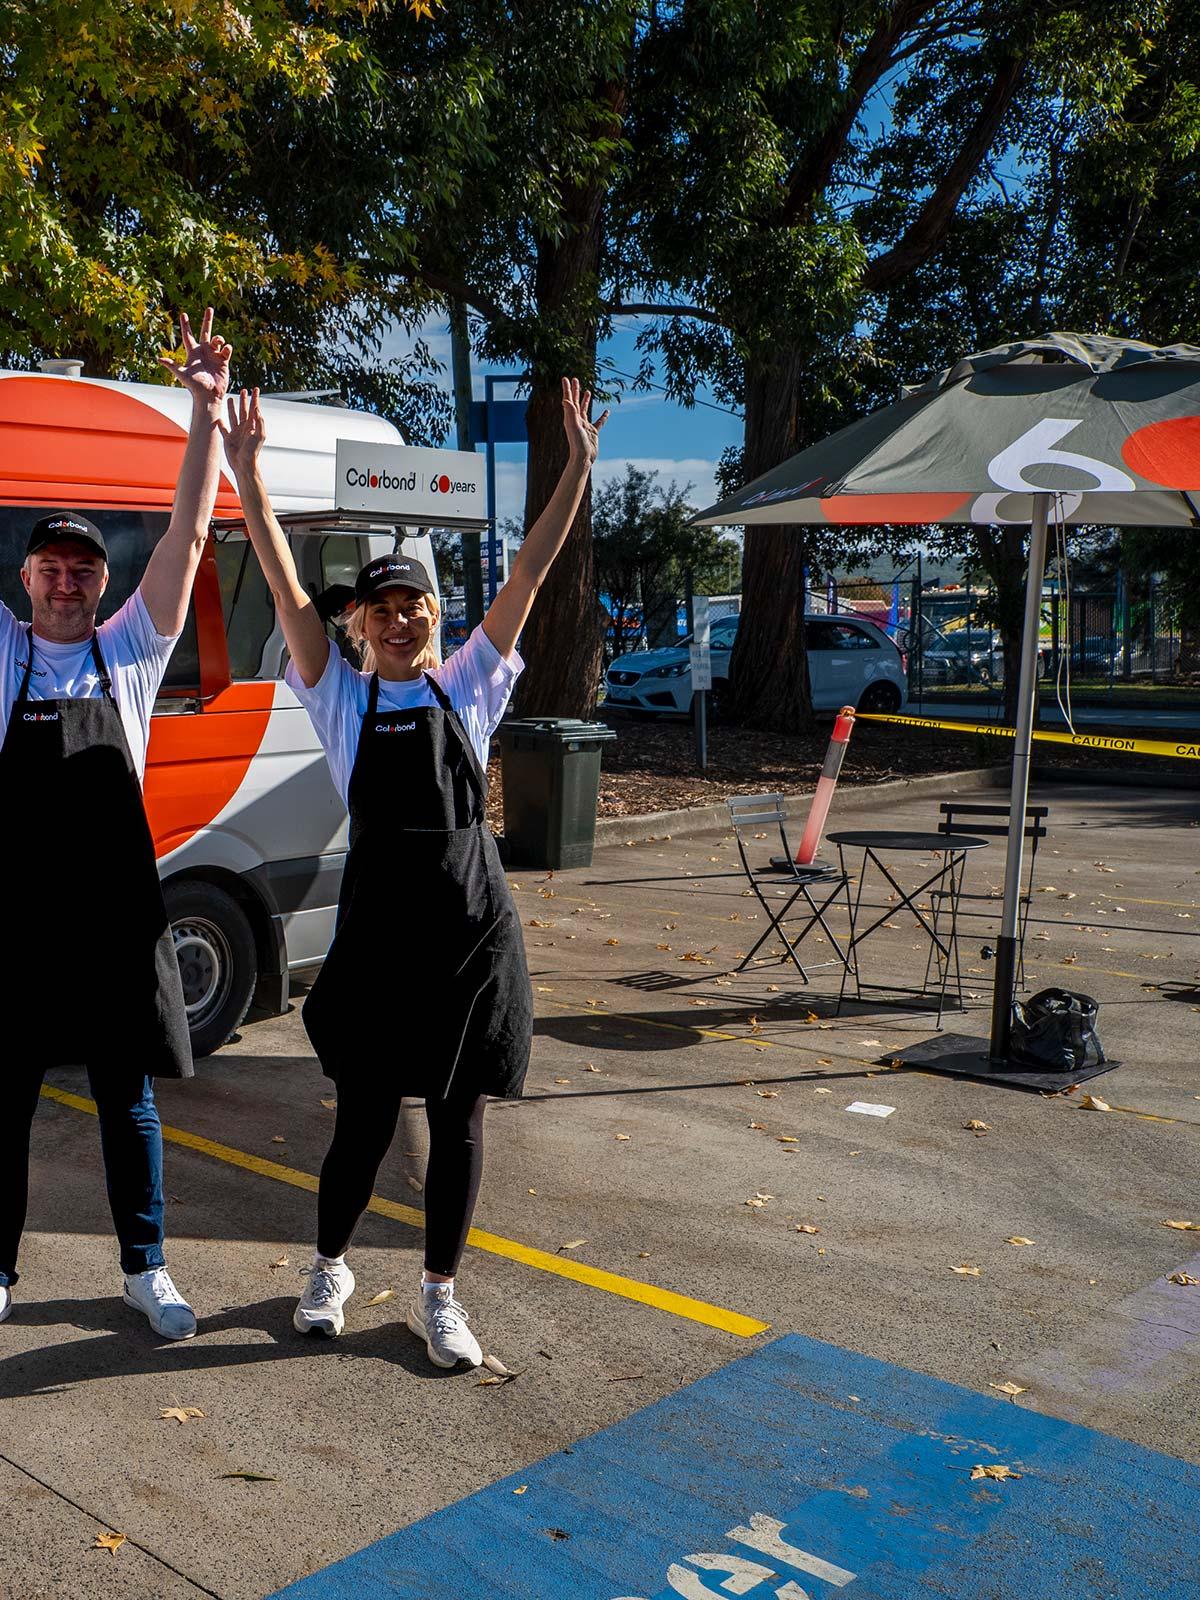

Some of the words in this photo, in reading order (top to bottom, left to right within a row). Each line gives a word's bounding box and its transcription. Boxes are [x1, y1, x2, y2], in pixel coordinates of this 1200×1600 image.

[48, 521, 88, 533] Colorbond
[369, 563, 411, 579] Colorbond
[374, 721, 416, 733] Colorbond
[1071, 736, 1135, 750] CAUTION
